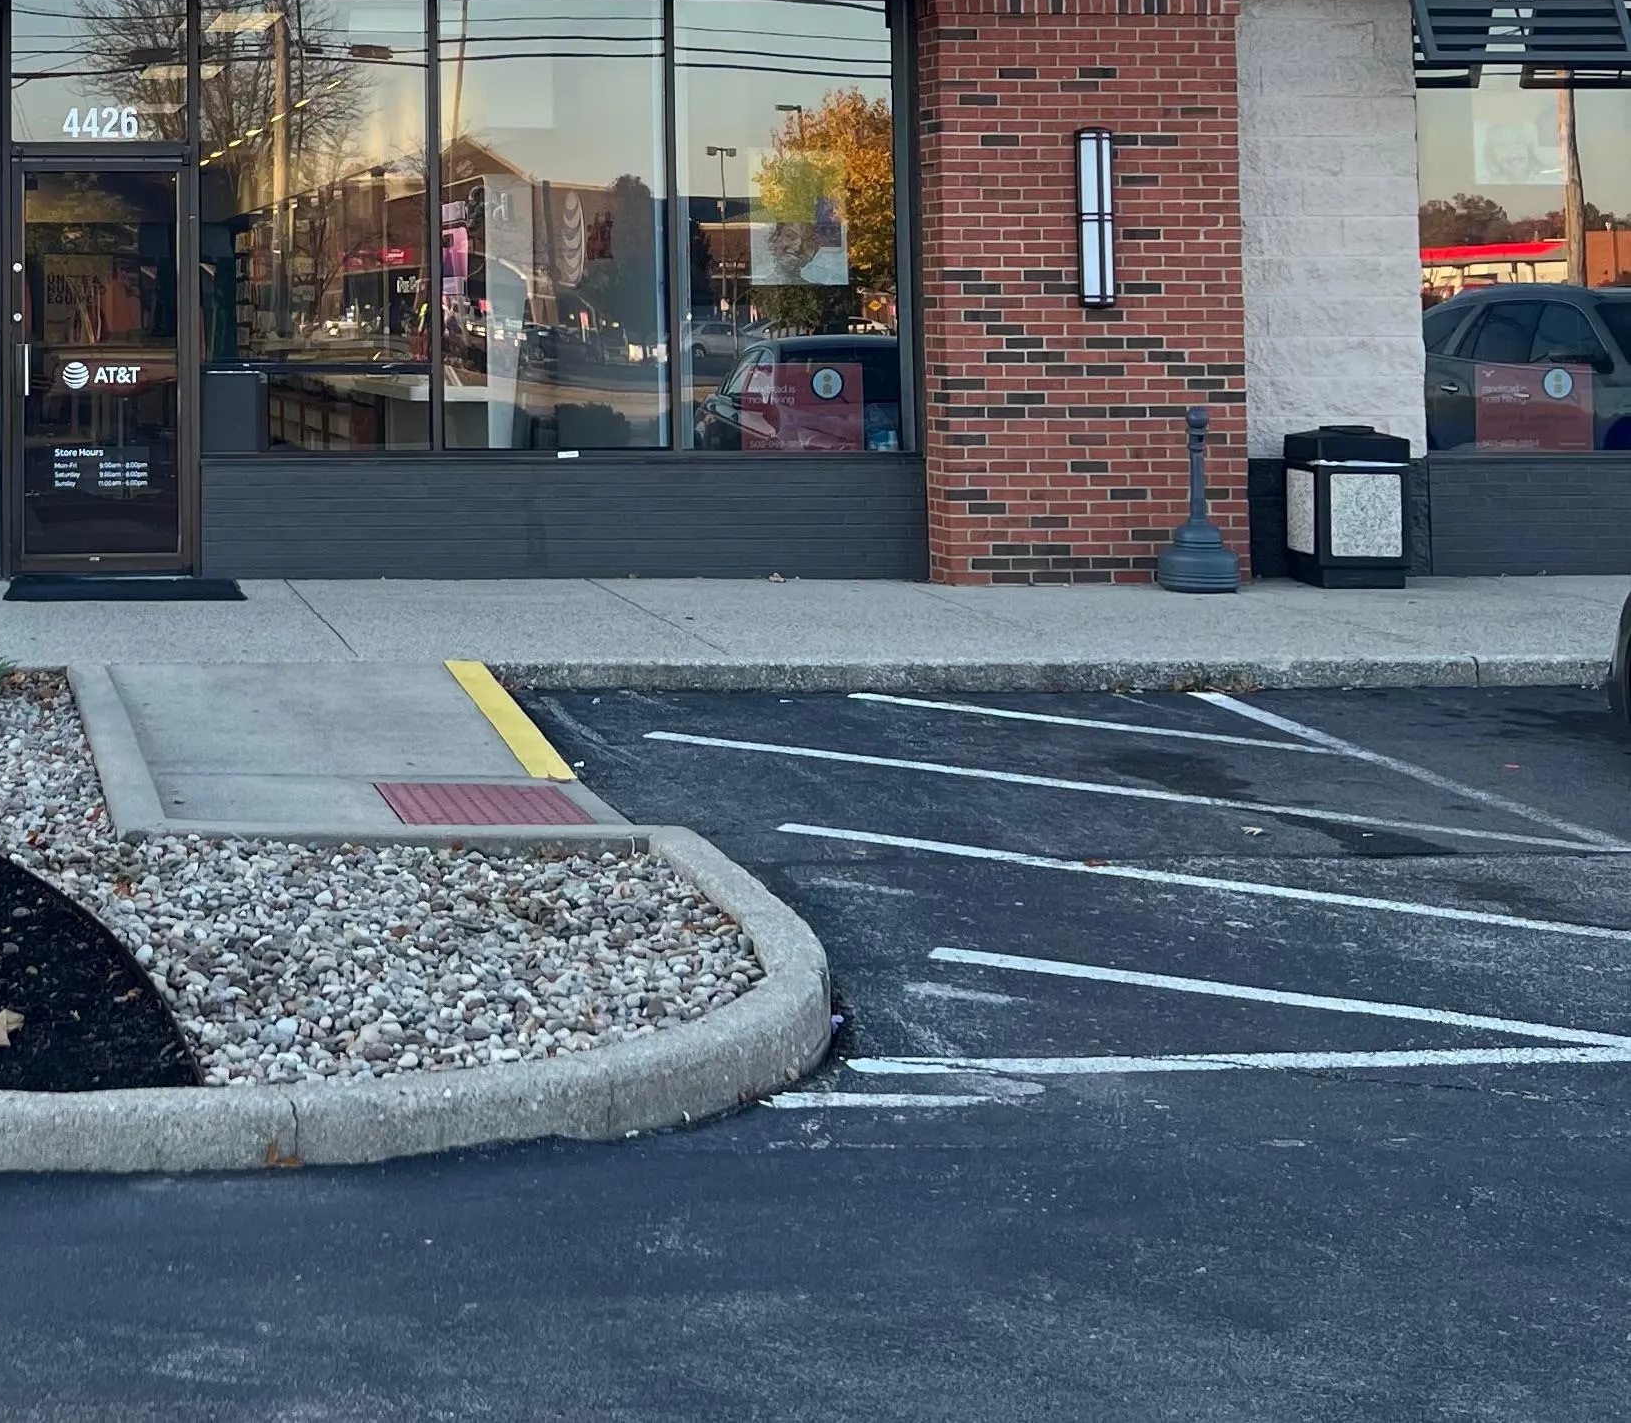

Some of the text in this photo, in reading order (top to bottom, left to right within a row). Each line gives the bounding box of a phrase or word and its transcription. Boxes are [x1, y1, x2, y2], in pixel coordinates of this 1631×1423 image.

[62, 106, 138, 138] 4426
[94, 366, 141, 384] AT&T
[54, 449, 104, 457] Store Hours
[54, 480, 77, 488] Sunday
